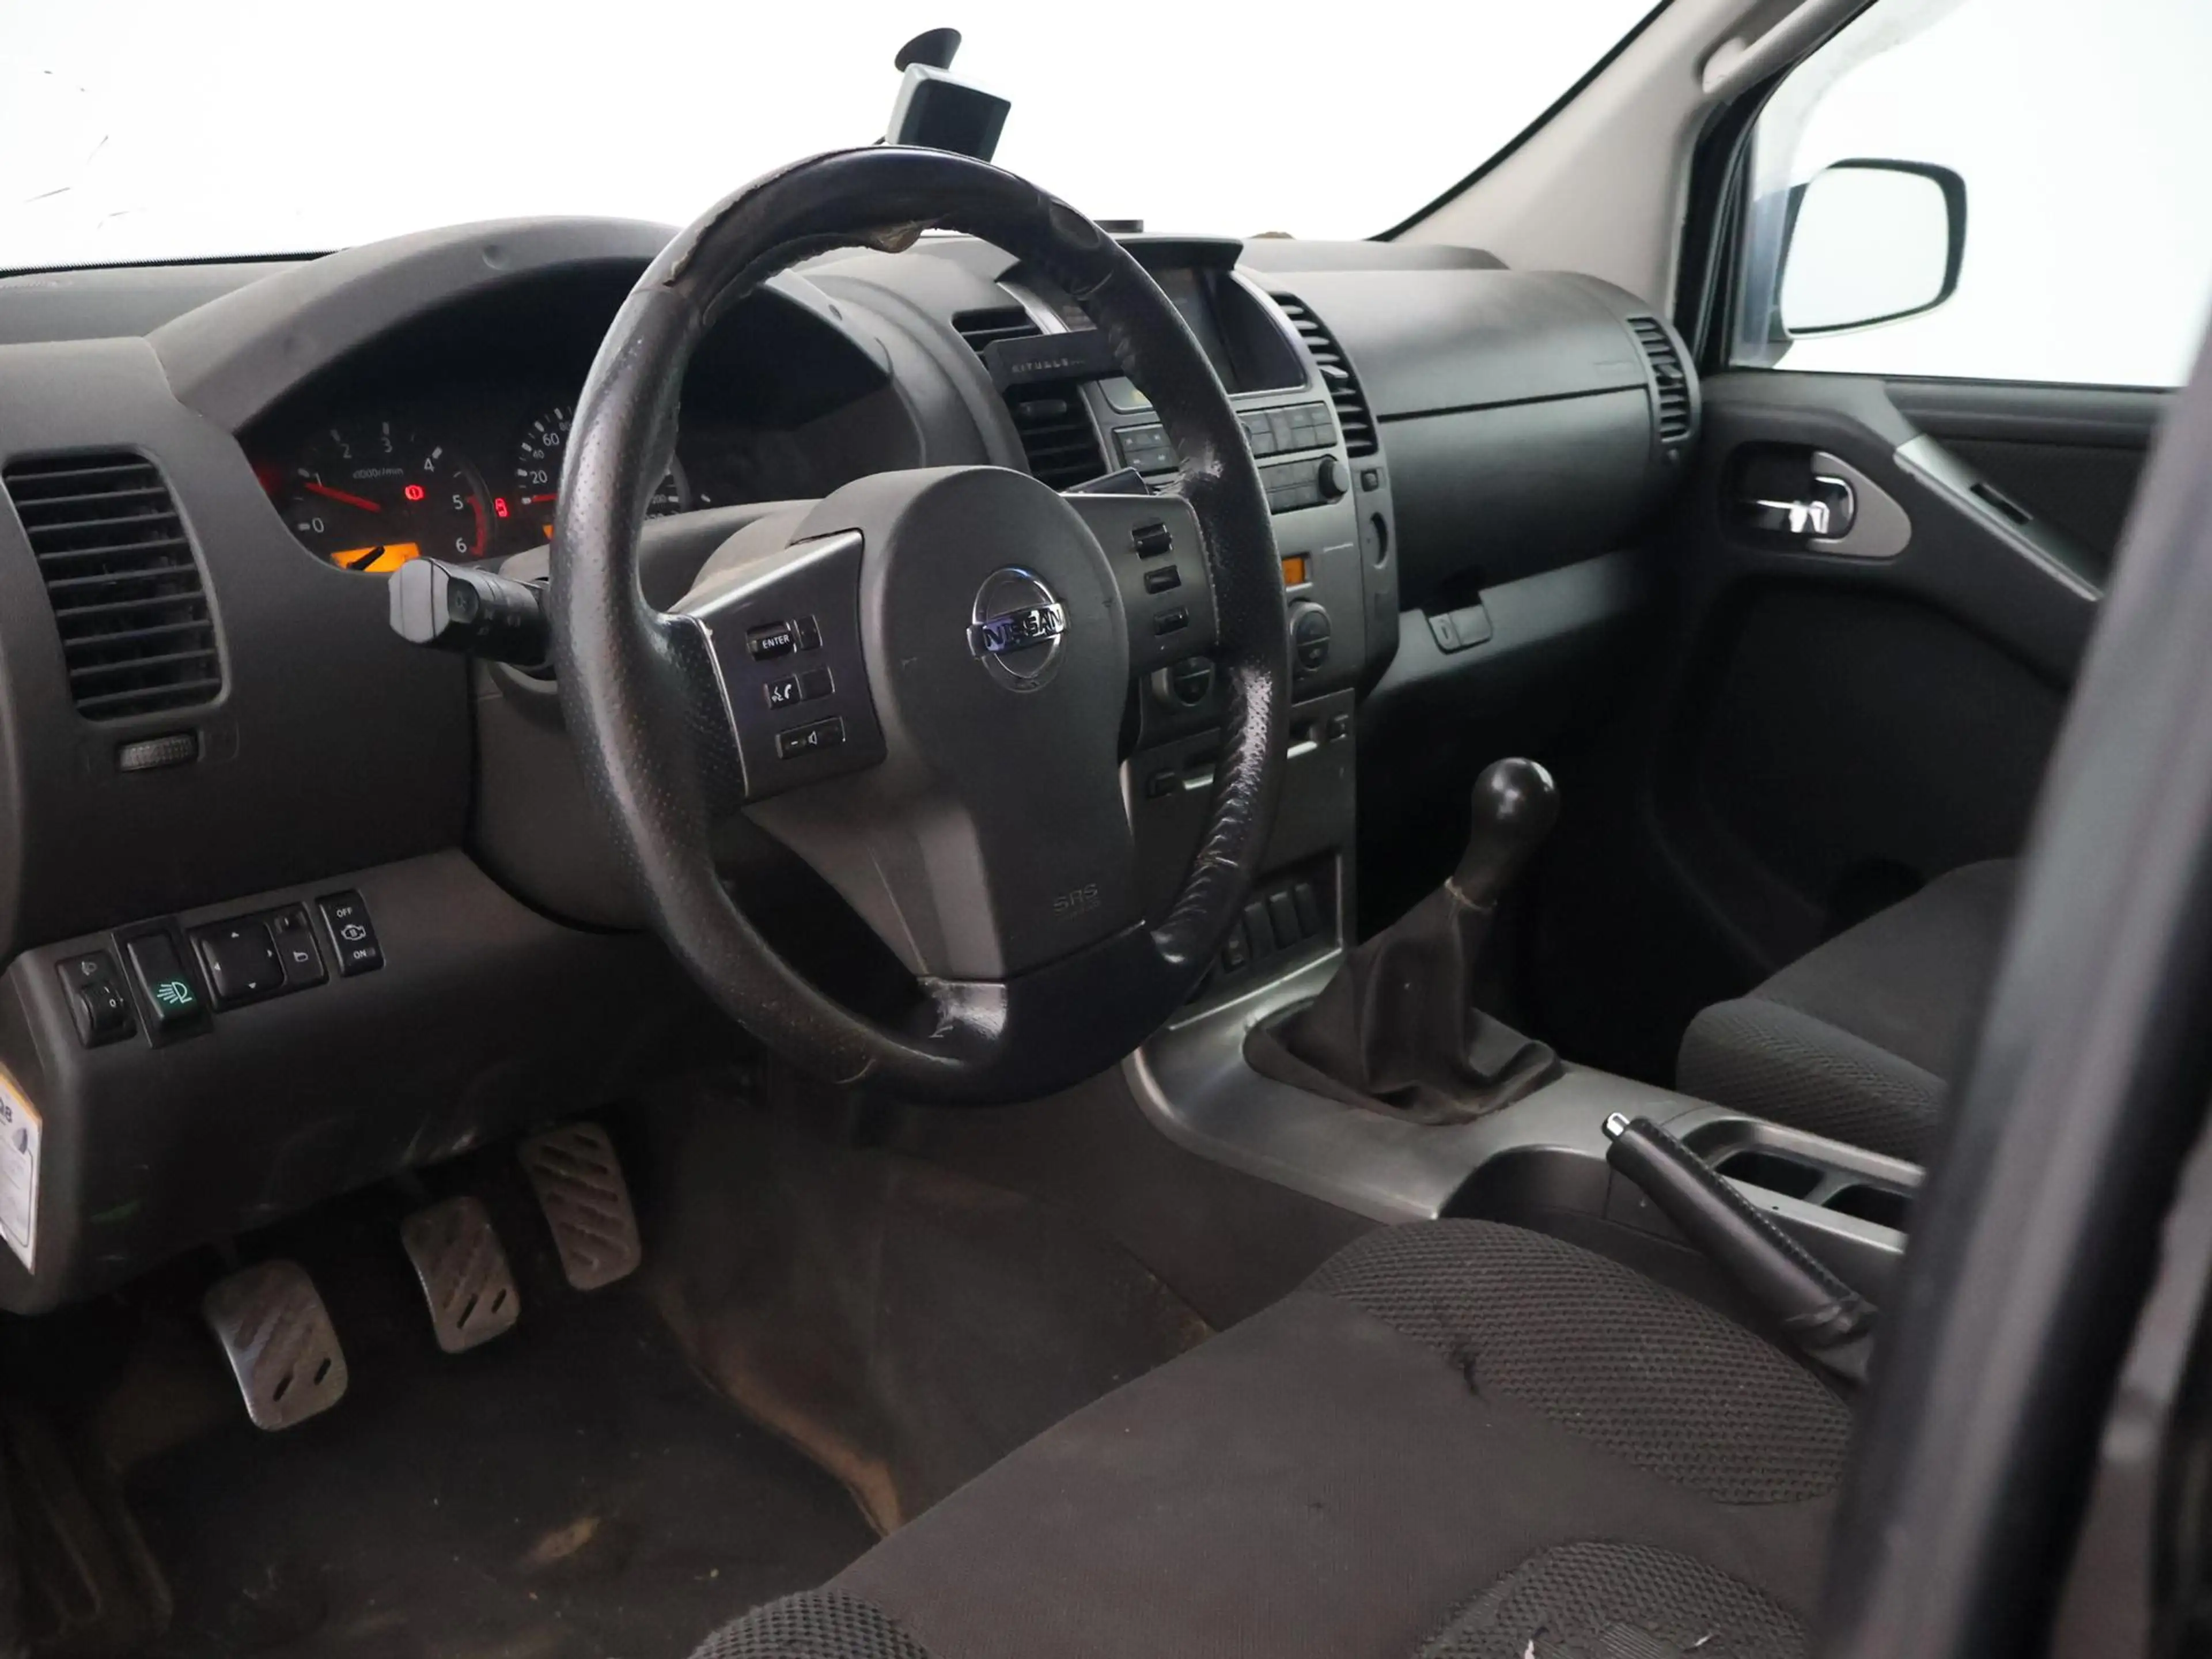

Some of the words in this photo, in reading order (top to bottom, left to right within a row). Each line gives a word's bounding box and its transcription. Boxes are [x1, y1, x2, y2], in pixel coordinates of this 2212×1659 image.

[381, 436, 393, 453] 3
[542, 433, 560, 447] 60
[339, 442, 353, 459] 2
[533, 449, 545, 460] 40
[423, 457, 435, 473] 4
[529, 469, 548, 484] 20
[452, 494, 464, 510] 5
[312, 517, 324, 533] 0
[455, 537, 467, 553] 6
[983, 607, 1065, 650] NISSAN
[762, 634, 790, 650] ENTER
[336, 907, 353, 918] OFF
[353, 949, 367, 960] ON
